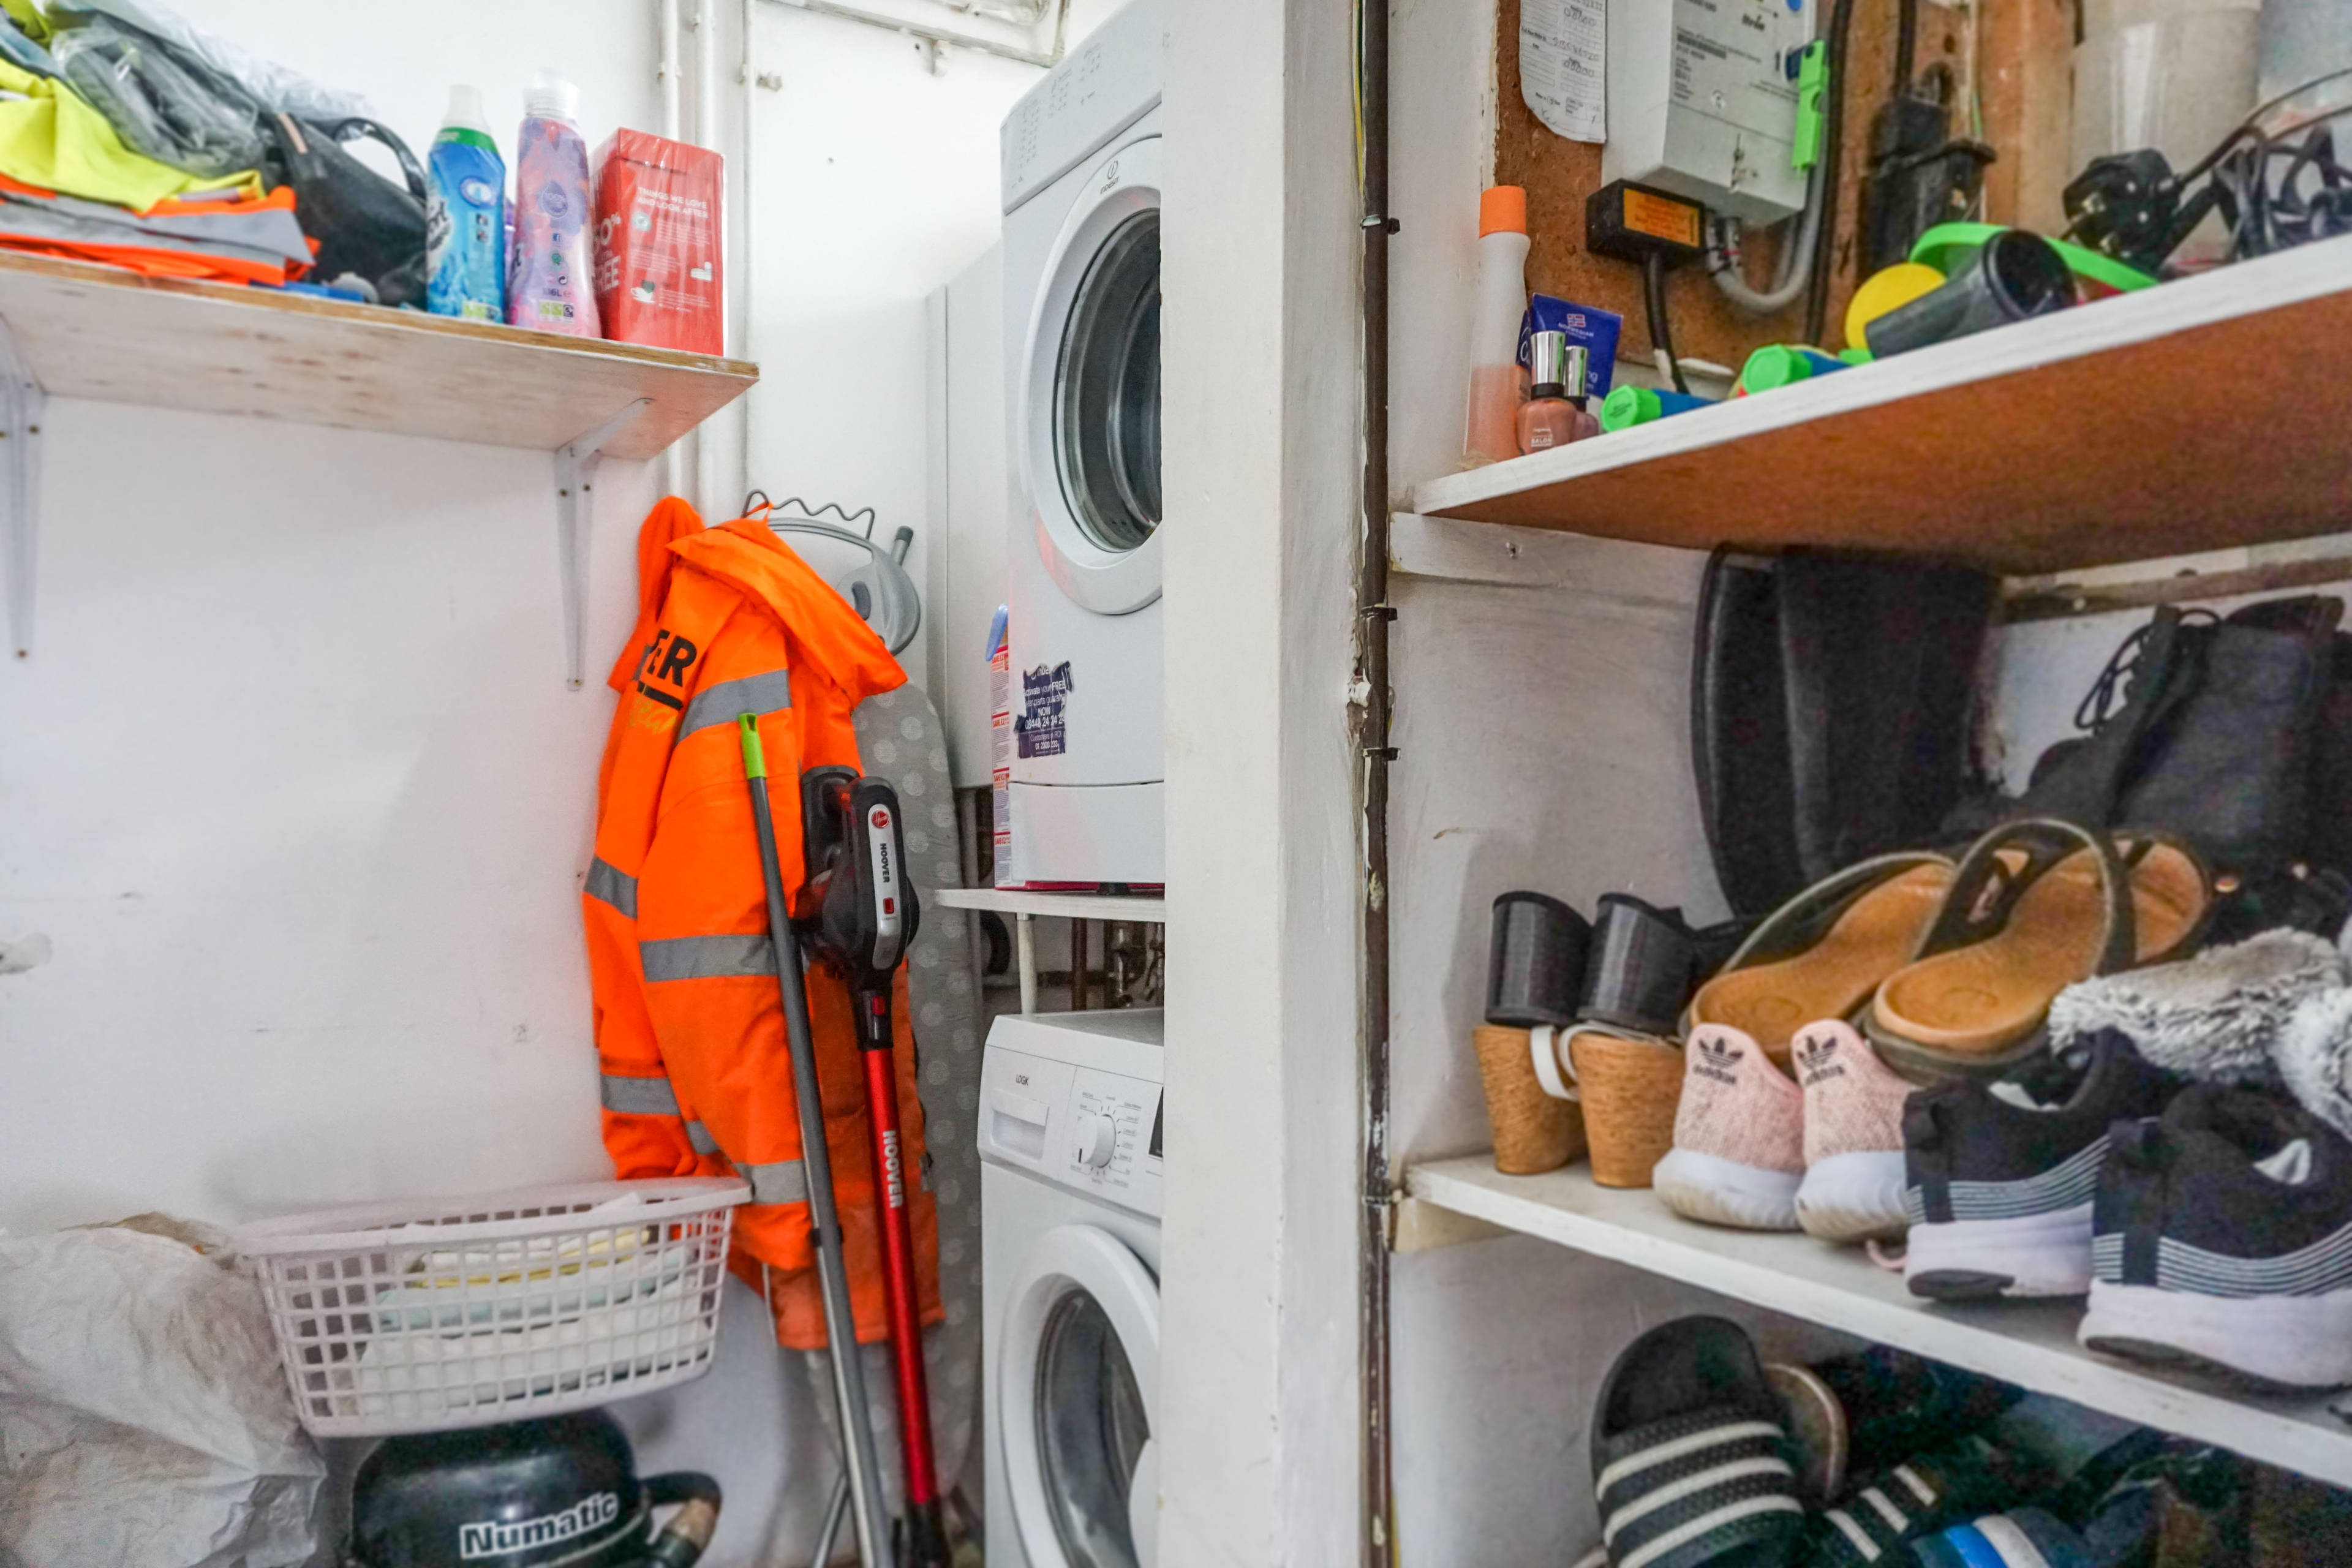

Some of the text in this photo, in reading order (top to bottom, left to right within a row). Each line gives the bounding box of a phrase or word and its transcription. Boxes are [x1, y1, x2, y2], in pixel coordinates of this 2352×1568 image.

[638, 186, 707, 209] THINGS WE LOVE
[638, 197, 708, 219] AND LOOK AFTER
[1025, 686, 1040, 697] ctivate
[1052, 679, 1066, 690] FREE
[1038, 706, 1050, 716] NOW
[1042, 717, 1049, 727] 24
[880, 843, 890, 883] HOOVER
[1016, 1074, 1029, 1087] LOGIK
[1693, 1064, 1737, 1085] adidas
[883, 1129, 903, 1208] HOOVER
[461, 1492, 619, 1559] Numatic
